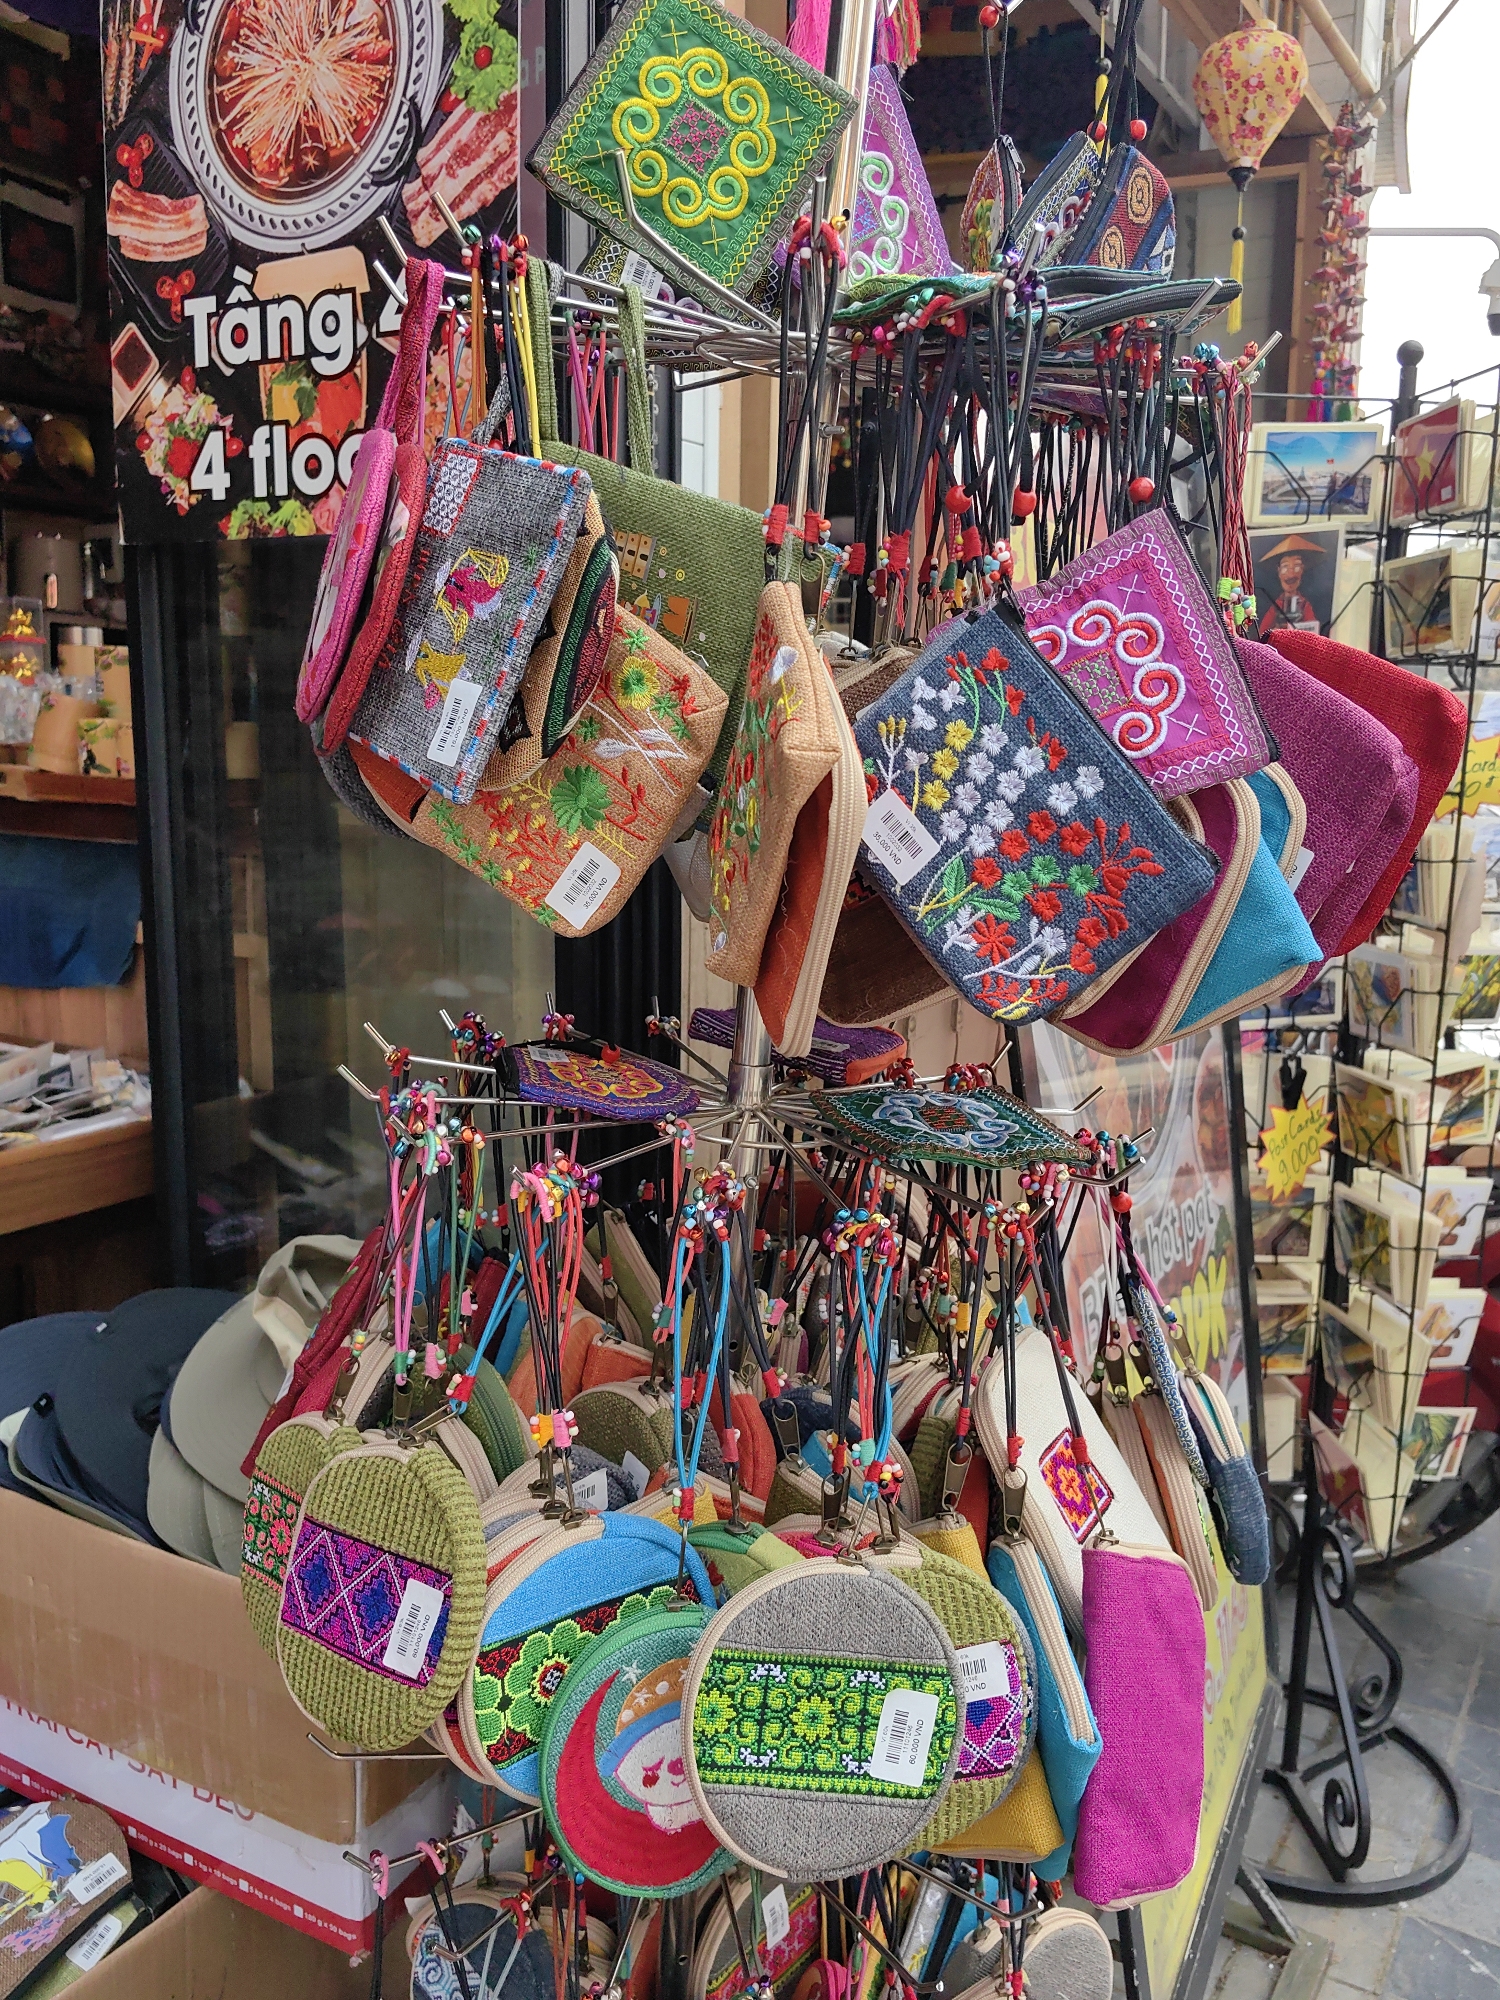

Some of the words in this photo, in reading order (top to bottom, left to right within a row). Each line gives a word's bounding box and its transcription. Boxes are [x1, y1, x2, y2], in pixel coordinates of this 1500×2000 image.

[183, 266, 356, 376] Tầng
[190, 430, 230, 500] 4
[872, 831, 892, 852] 35,000
[888, 848, 902, 866] VND
[595, 877, 608, 892] VND
[1289, 1109, 1322, 1140] Cards
[1146, 1201, 1183, 1280] hot
[1181, 1176, 1218, 1266] pot
[412, 1632, 424, 1659] 60,000
[420, 1614, 431, 1632] VND
[970, 1682, 987, 1692] VND
[913, 1718, 925, 1738] VND
[908, 1736, 921, 1766] 60,000
[274, 1898, 291, 1911] bags
[338, 1927, 357, 1941] bags
